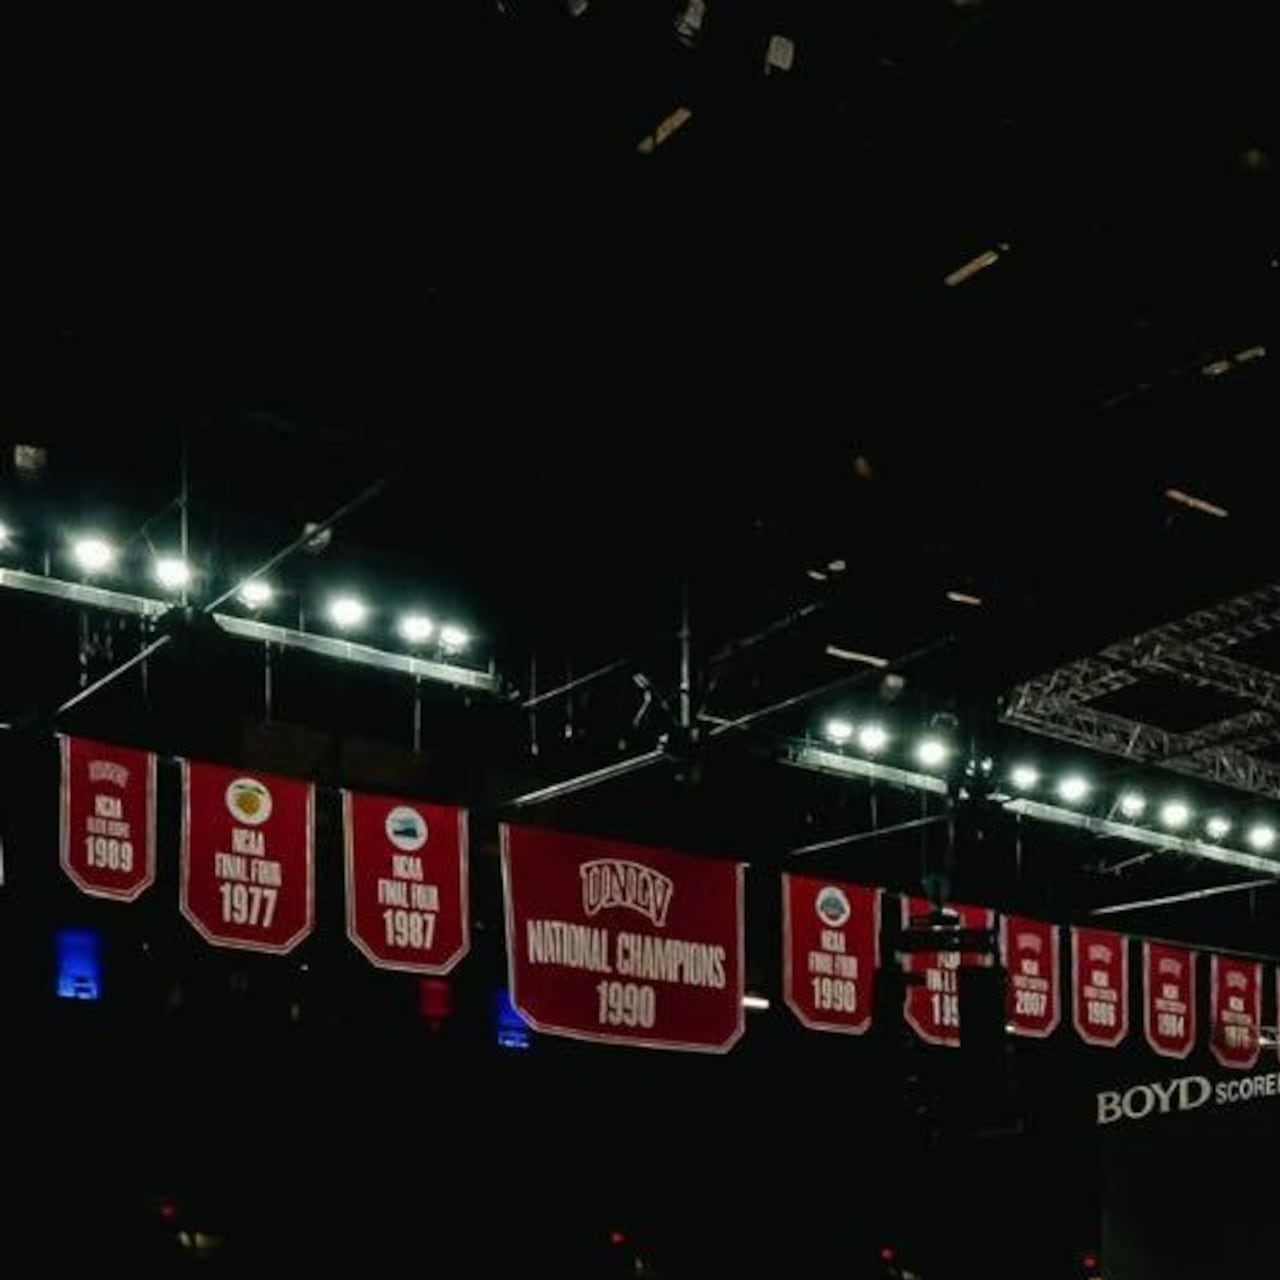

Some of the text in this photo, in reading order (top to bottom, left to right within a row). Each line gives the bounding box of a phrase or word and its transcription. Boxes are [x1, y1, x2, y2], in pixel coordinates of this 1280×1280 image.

[219, 882, 279, 929] 1977
[579, 858, 674, 928] UNLV
[382, 912, 437, 951] 1987
[525, 920, 726, 990] NATIONAL CHAMPIONS
[596, 981, 656, 1028] 1990
[1096, 1075, 1212, 1125] BOYD
